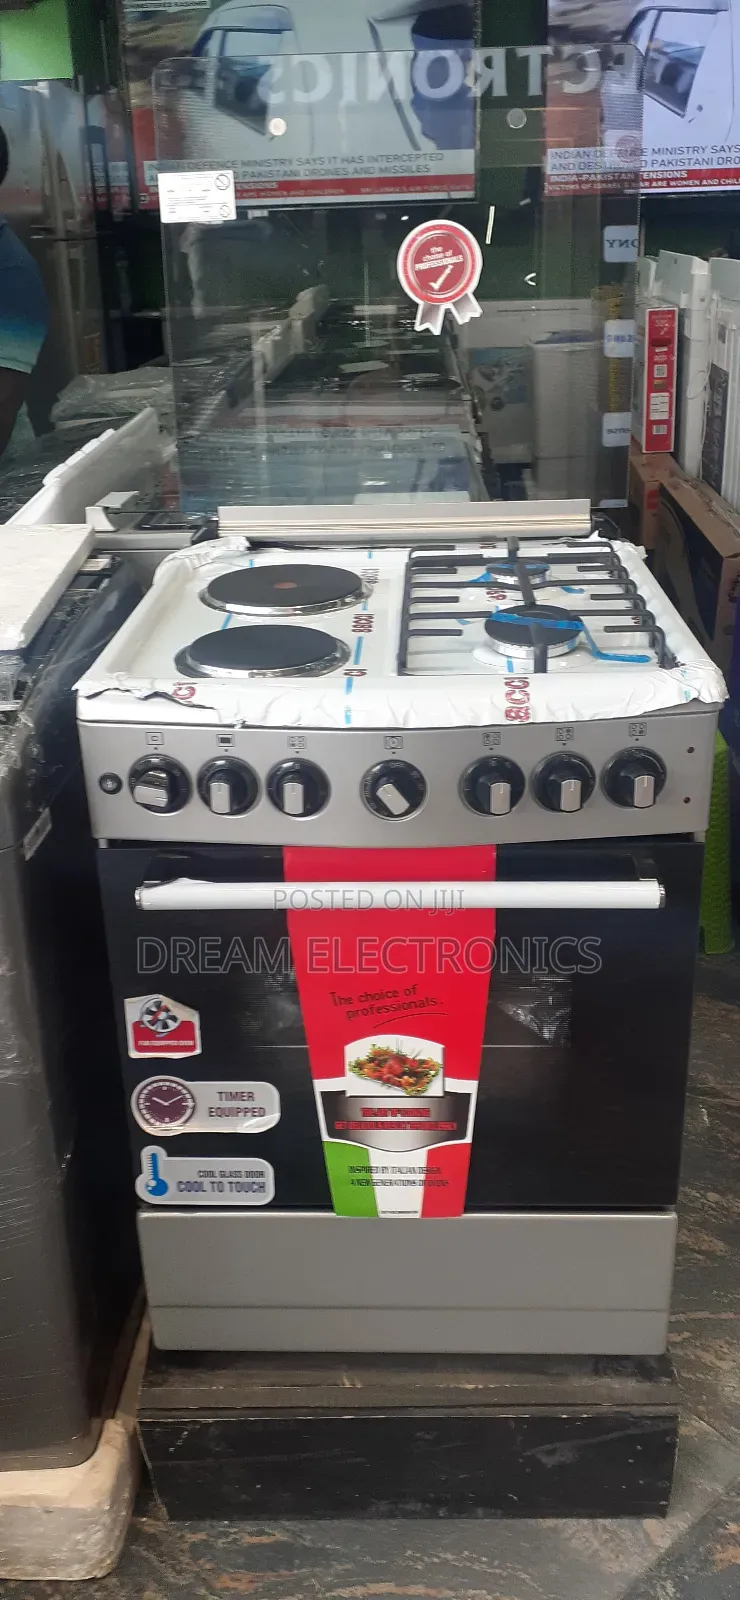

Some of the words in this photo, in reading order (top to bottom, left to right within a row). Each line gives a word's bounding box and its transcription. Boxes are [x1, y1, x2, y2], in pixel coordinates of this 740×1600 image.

[651, 146, 708, 156] MINISTRY
[710, 144, 740, 154] SAYS
[240, 158, 293, 168] MINISTRY
[295, 156, 326, 166] SAYS
[327, 157, 338, 165] IT
[343, 155, 364, 165] HAS
[366, 152, 445, 164] INTERCEPTED
[551, 162, 575, 171] AND
[651, 157, 714, 168] PAKISTANI
[242, 167, 304, 179] PAKISTANI
[304, 167, 348, 178] DRONES
[353, 166, 375, 176] AND
[378, 164, 430, 174] MISSILES
[669, 179, 700, 187] WOMEN
[702, 178, 719, 186] AND
[329, 991, 354, 1007] The
[357, 989, 400, 1004] choice
[403, 984, 417, 997] of
[217, 1091, 255, 1102] TIMER
[208, 1106, 266, 1118] EQUIPPED
[198, 1170, 218, 1179] COOL
[219, 1170, 243, 1179] GLASS
[245, 1170, 266, 1179] DOOR
[176, 1181, 207, 1193] COOL
[210, 1181, 226, 1193] TO
[229, 1181, 266, 1193] TOUCH
